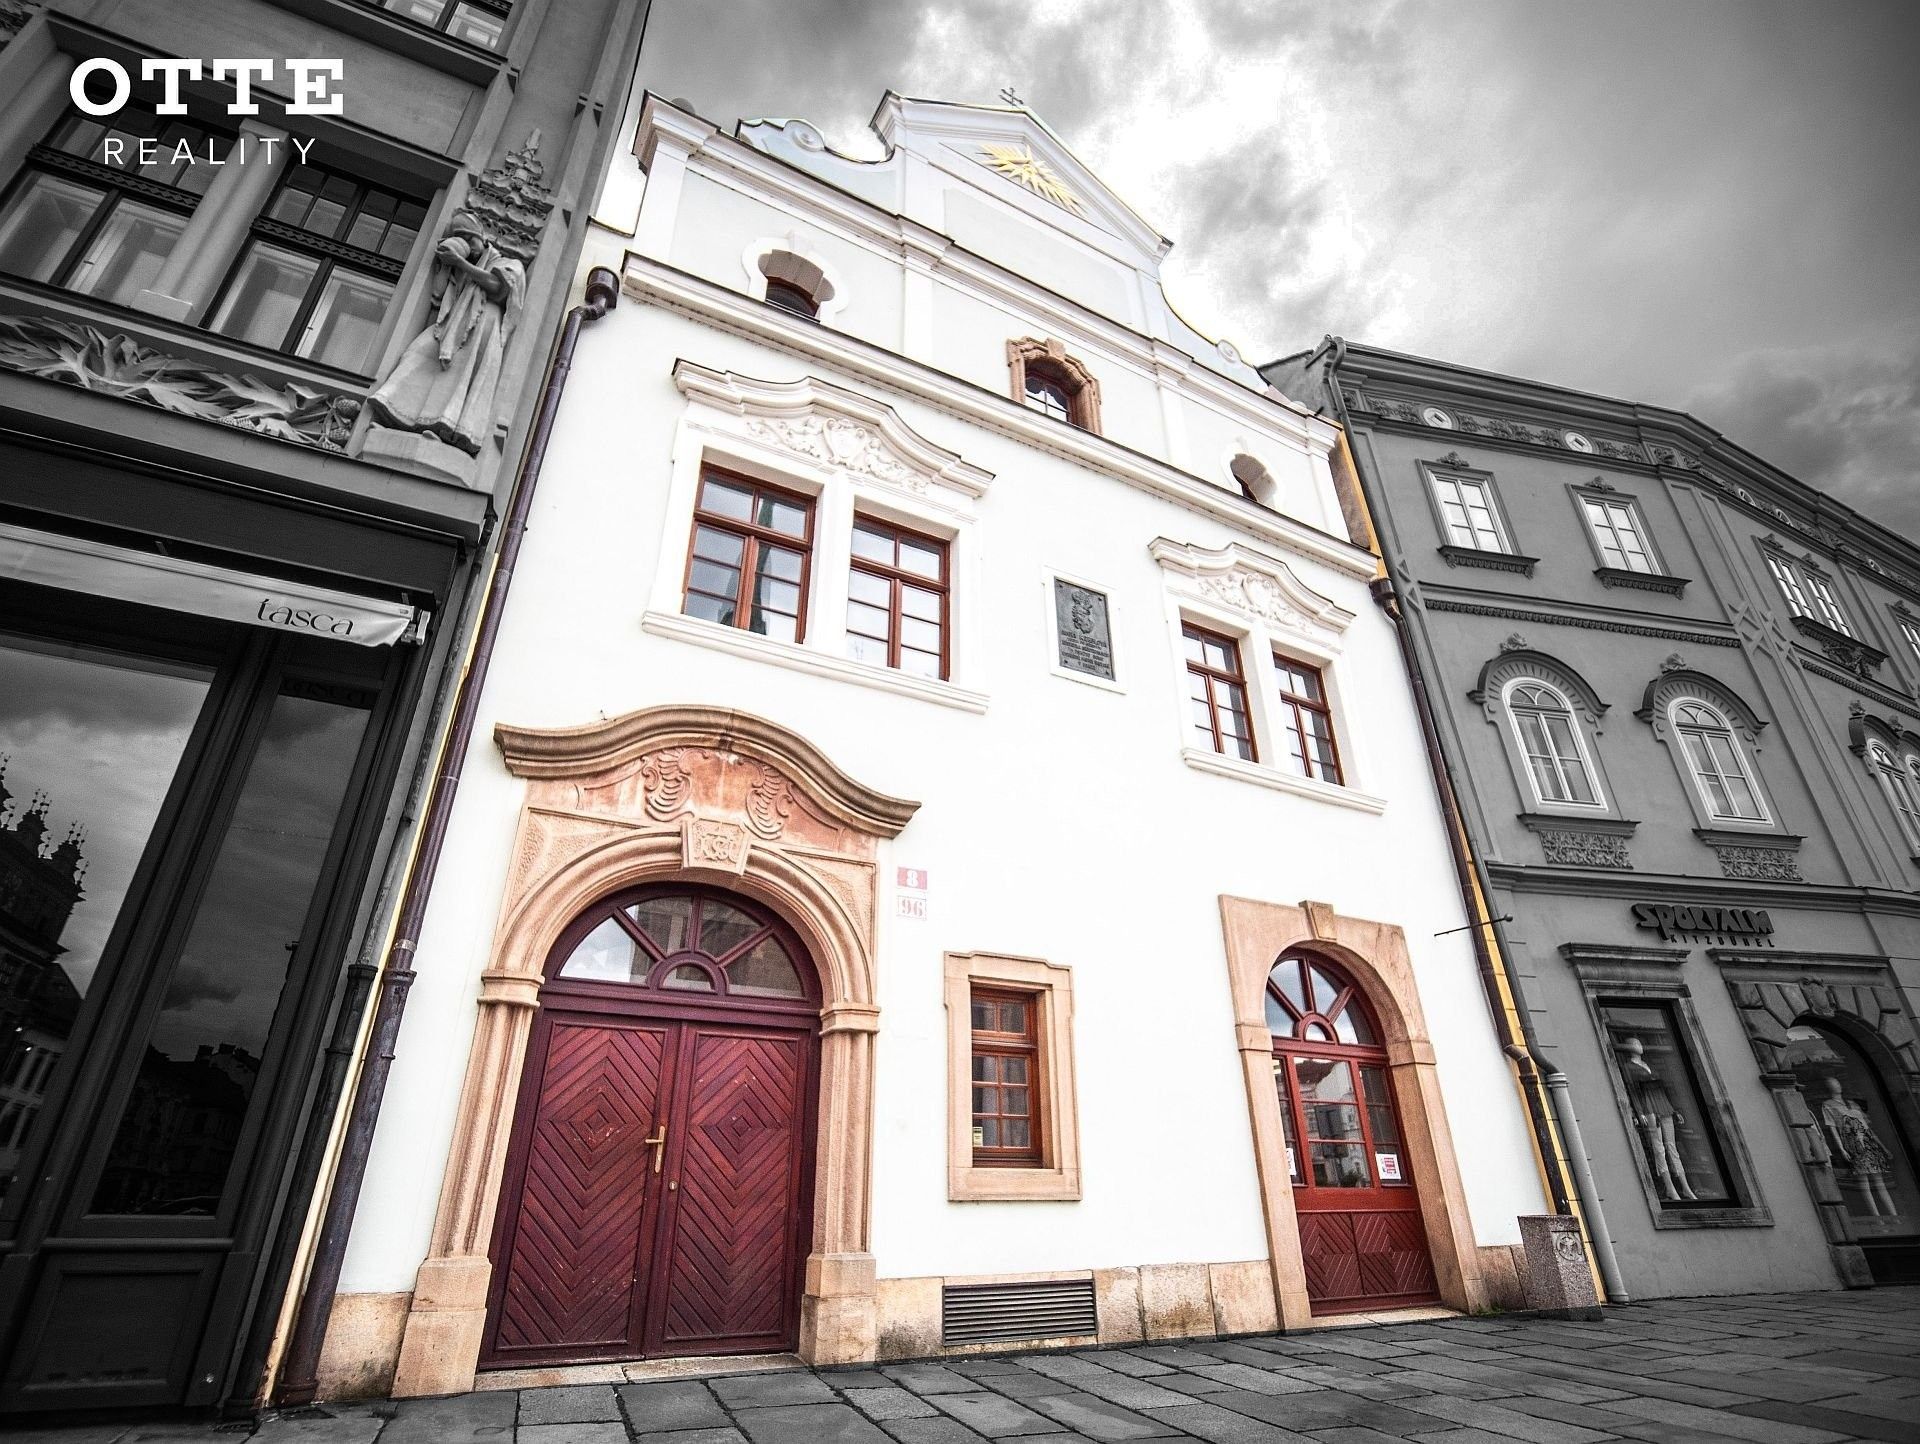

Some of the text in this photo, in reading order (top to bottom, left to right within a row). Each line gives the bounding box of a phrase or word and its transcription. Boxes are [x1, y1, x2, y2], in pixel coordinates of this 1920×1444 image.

[256, 598, 354, 635] tasca
[906, 869, 918, 887] 8
[902, 899, 923, 917] 96
